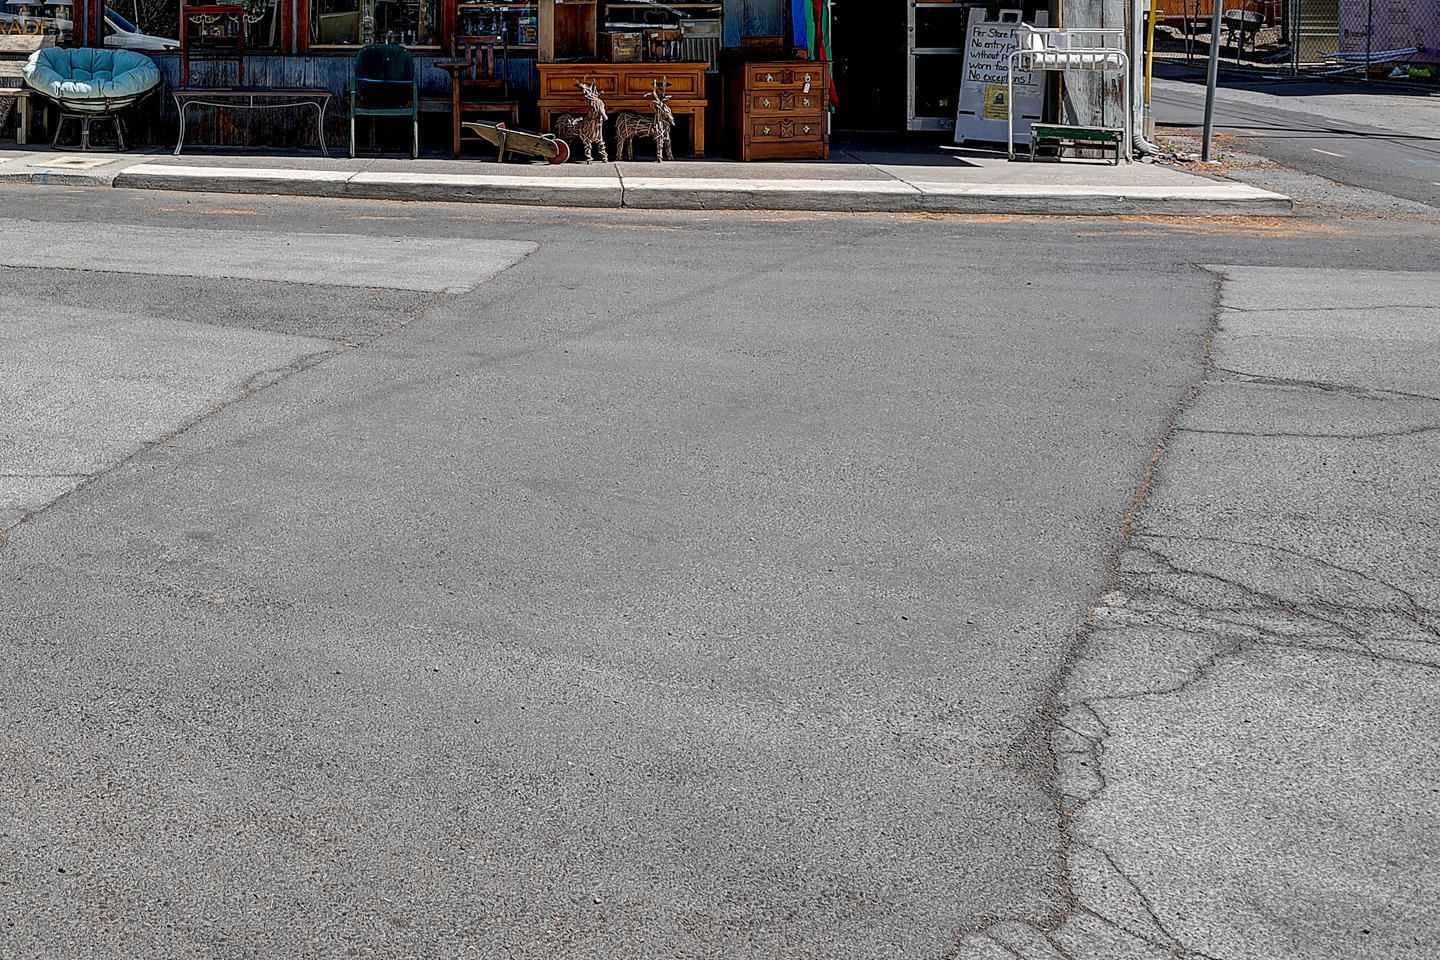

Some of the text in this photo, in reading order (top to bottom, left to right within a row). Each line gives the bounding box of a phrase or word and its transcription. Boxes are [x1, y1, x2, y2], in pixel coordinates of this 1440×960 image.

[973, 27, 986, 37] Per
[987, 28, 1008, 38] Store
[971, 38, 982, 48] No
[984, 40, 1006, 53] entry
[970, 50, 1000, 60] without
[969, 61, 992, 70] worn
[969, 70, 980, 80] No
